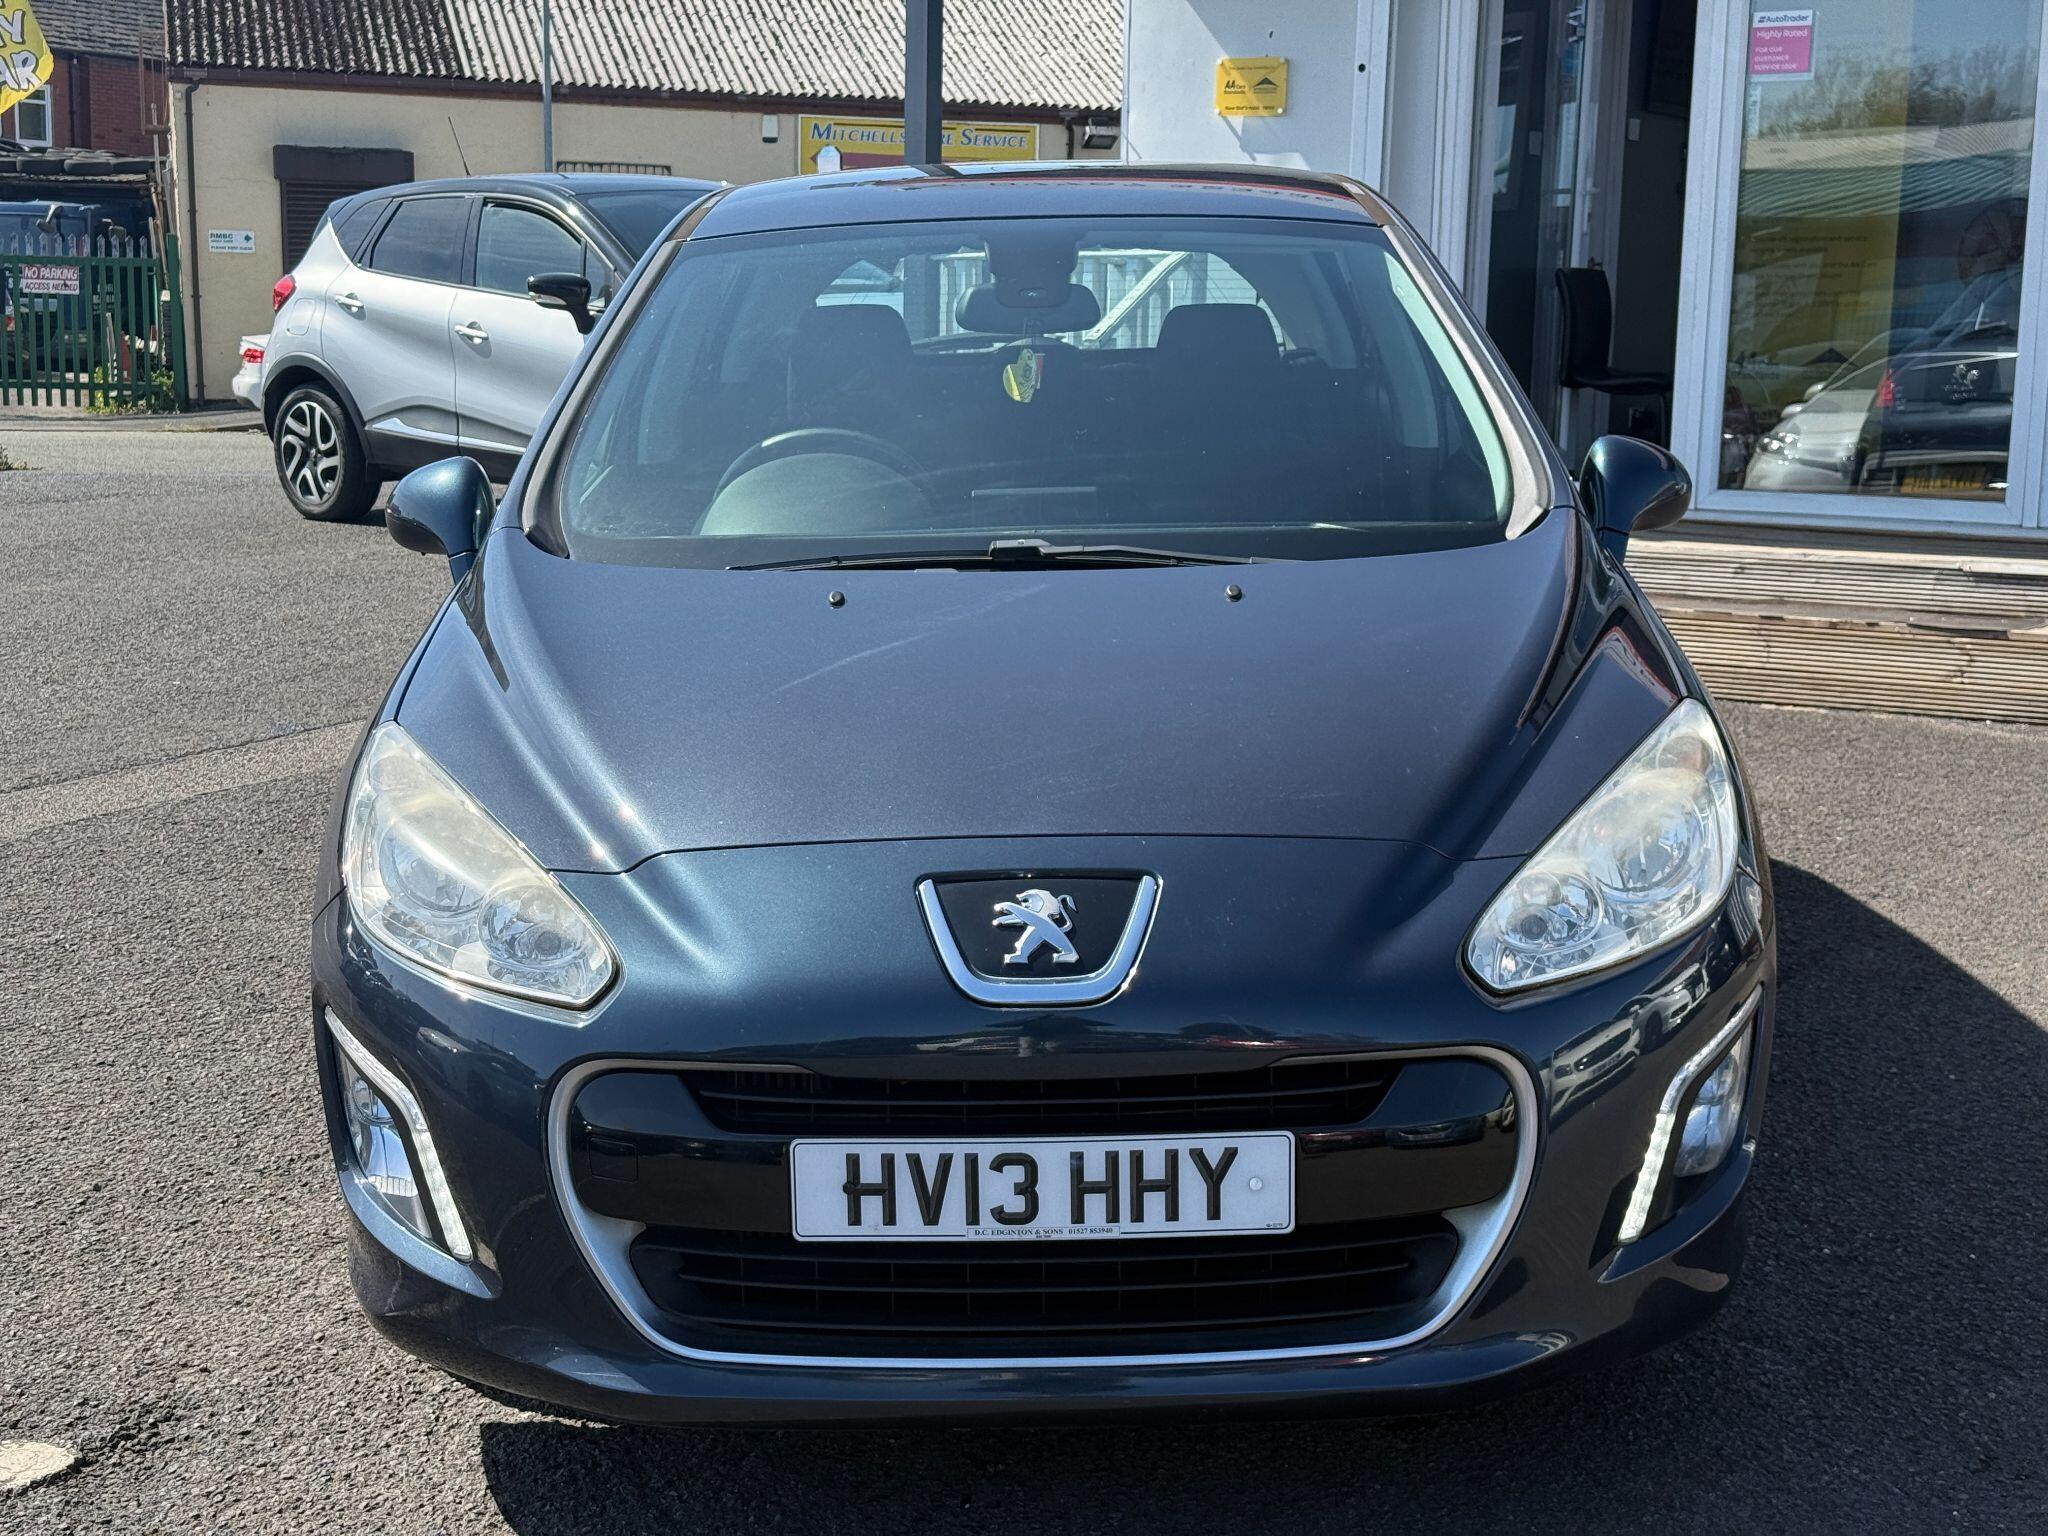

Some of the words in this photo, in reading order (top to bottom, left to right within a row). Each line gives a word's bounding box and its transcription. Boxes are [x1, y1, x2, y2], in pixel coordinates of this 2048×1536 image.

[1766, 14, 1809, 22] AutoTrader
[1756, 29, 1782, 39] Highly
[1783, 28, 1808, 37] Rated
[960, 128, 1026, 147] SERVICE
[24, 266, 38, 278] NO
[40, 267, 78, 280] PARKING
[24, 281, 50, 291] ACCESS
[844, 1152, 1040, 1227] HV13
[1070, 1147, 1239, 1225] HHY
[1068, 1227, 1088, 1235] 01527
